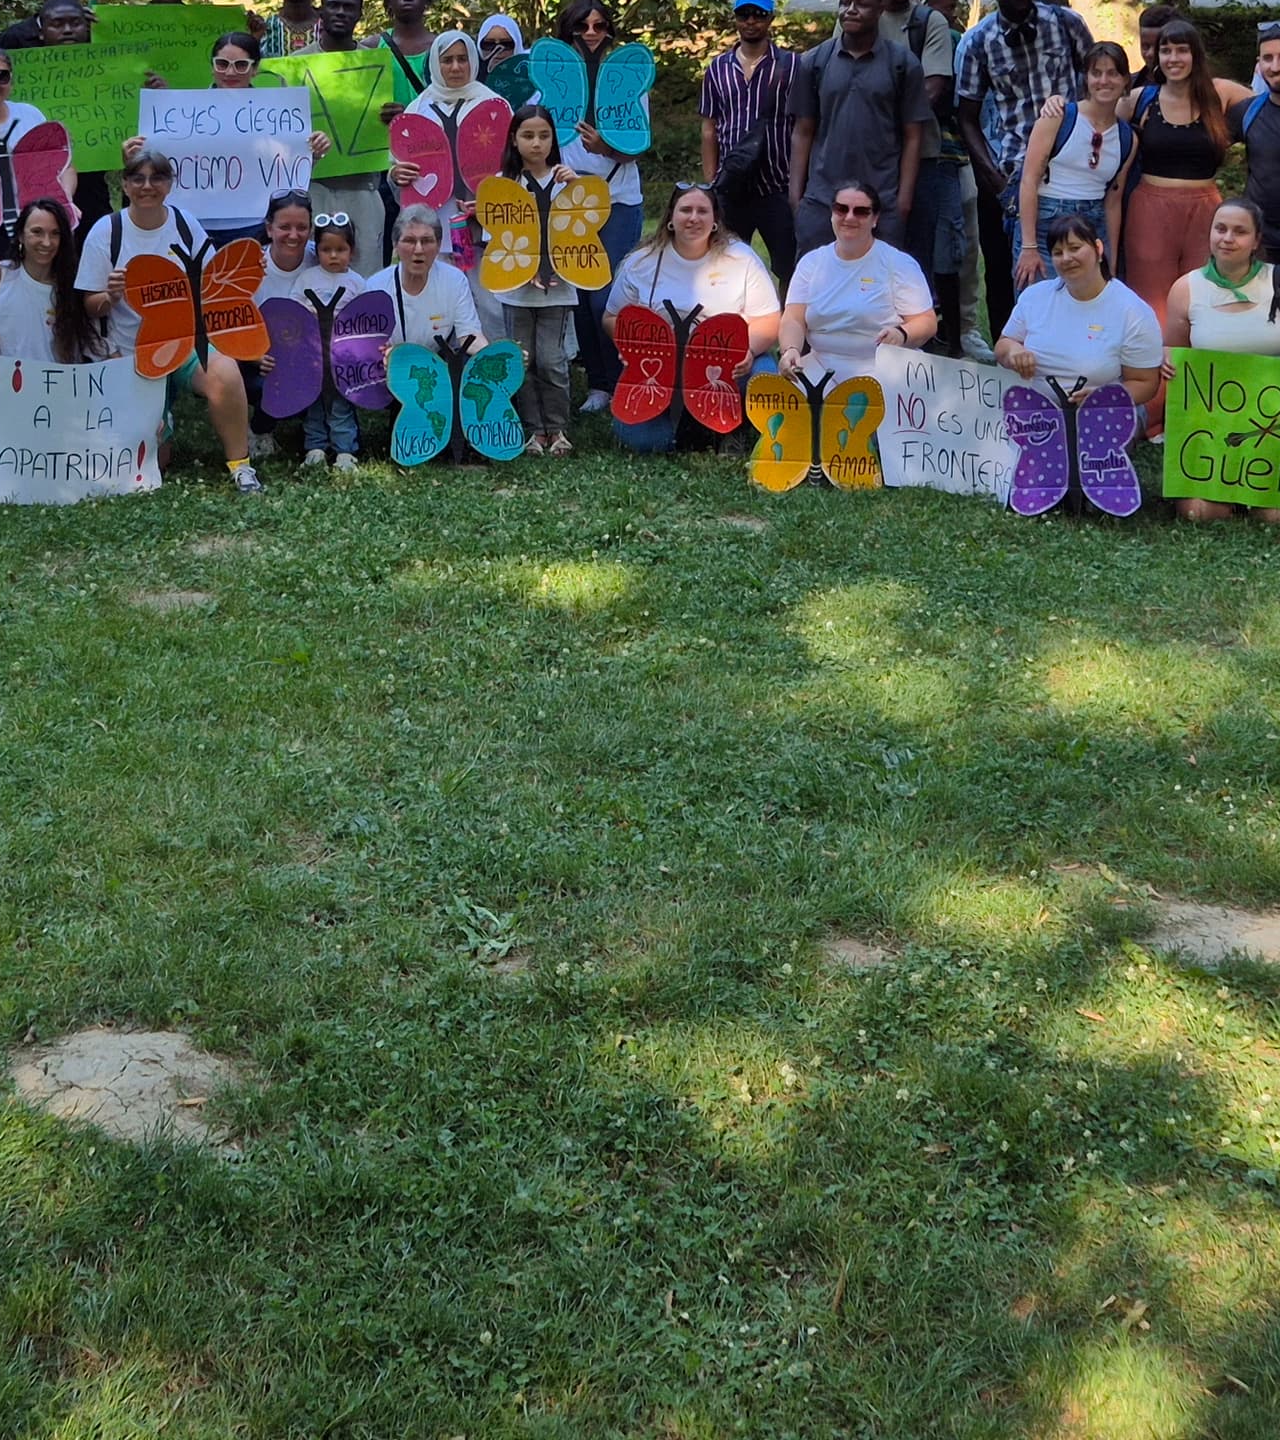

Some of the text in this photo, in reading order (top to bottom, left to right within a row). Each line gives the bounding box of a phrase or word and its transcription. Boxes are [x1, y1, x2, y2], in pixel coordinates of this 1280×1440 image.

[152, 105, 222, 141] LEYES
[551, 244, 601, 269] AMOR
[906, 360, 936, 393] MI
[1183, 360, 1247, 414] No
[749, 390, 800, 411] PATRIA
[896, 391, 926, 430] NO
[937, 410, 963, 436] ES
[33, 404, 114, 432] A LA
[827, 453, 878, 479] AMOR
